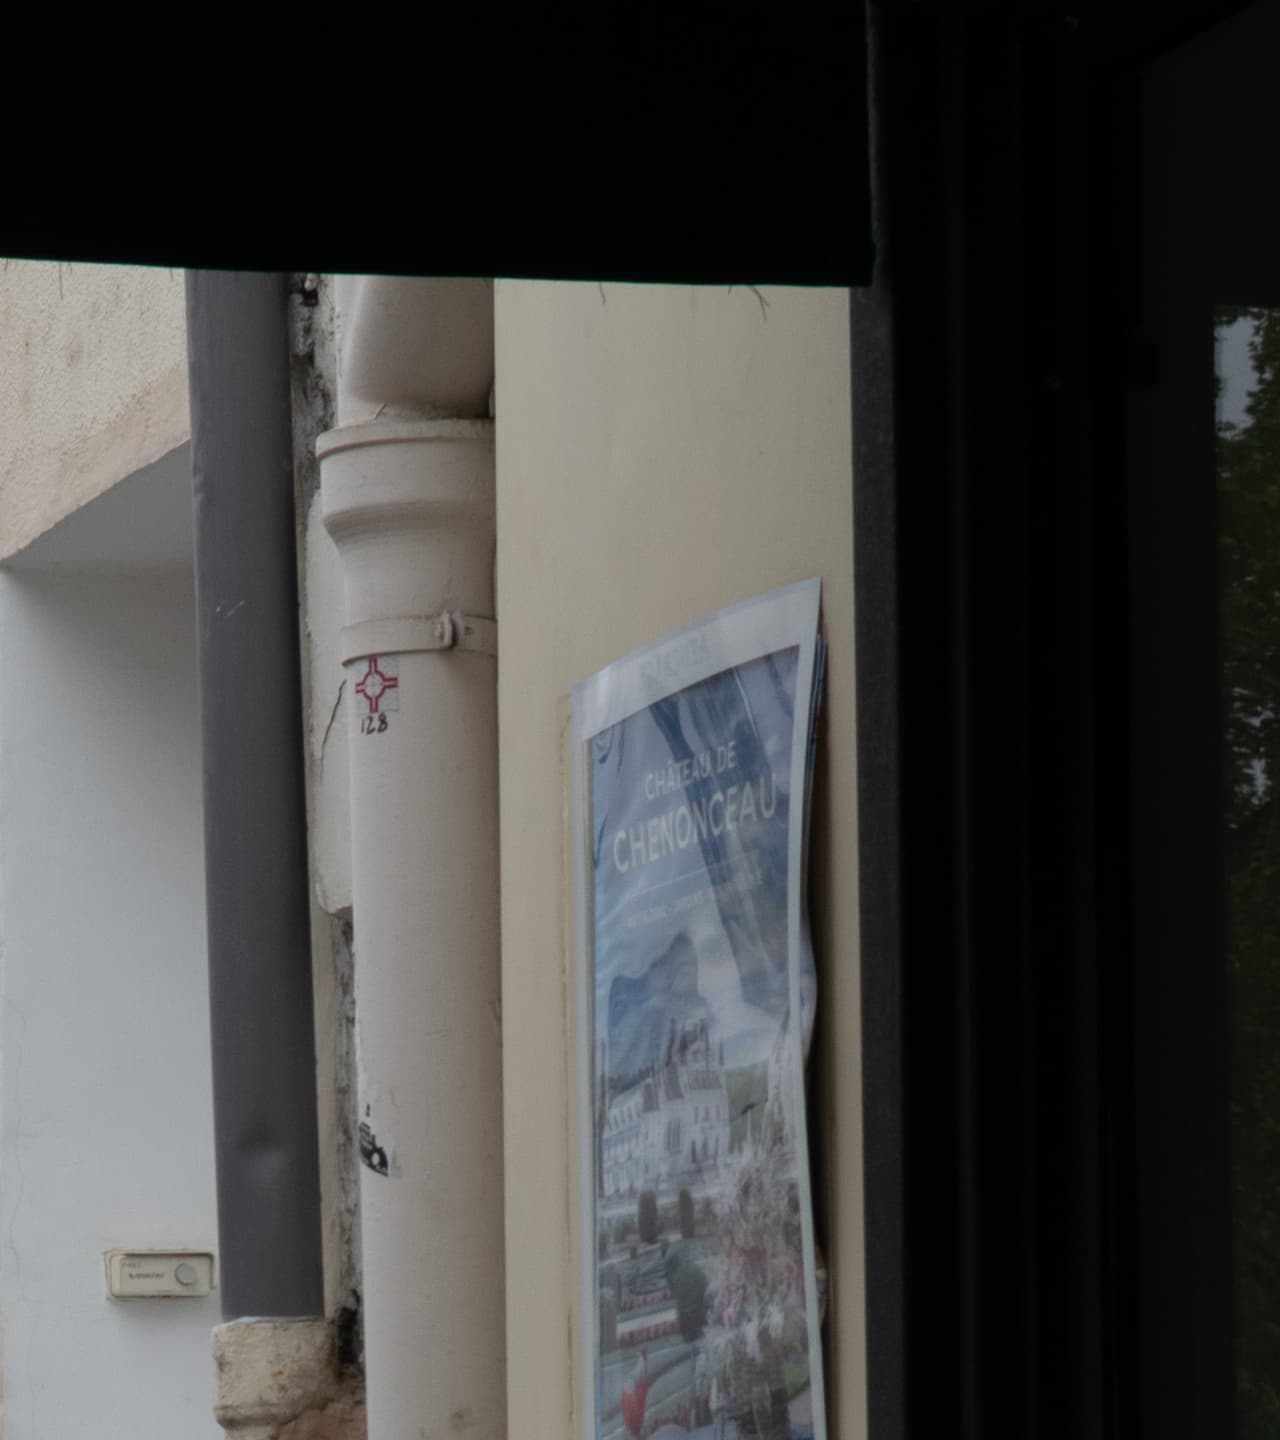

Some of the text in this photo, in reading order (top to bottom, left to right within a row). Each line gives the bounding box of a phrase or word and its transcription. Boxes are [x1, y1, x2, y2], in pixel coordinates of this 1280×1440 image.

[361, 712, 388, 735] 128
[645, 741, 737, 801] CHÂTEAU DE
[613, 773, 777, 873] CHENONCEAU
